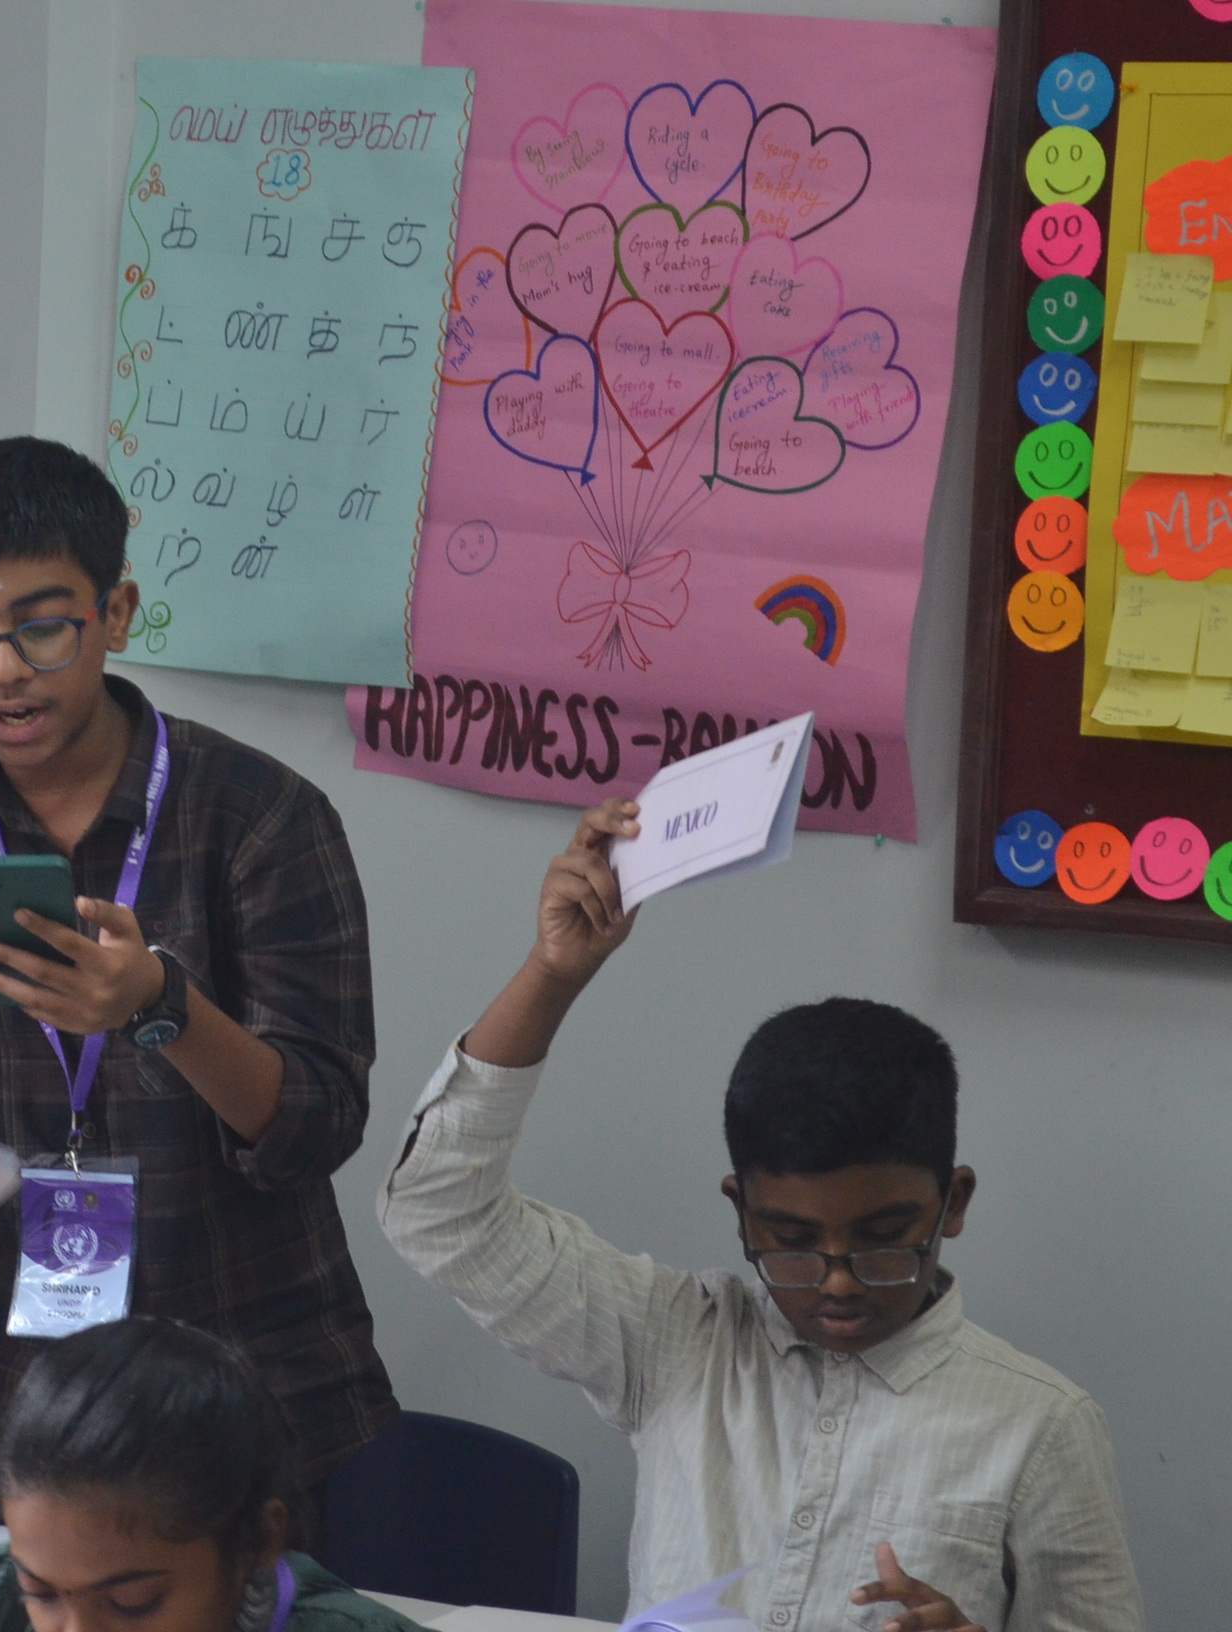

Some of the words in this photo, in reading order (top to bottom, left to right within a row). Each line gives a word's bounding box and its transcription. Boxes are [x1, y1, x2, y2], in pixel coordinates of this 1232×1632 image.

[648, 124, 690, 157] Riding
[700, 128, 709, 142] a
[265, 154, 302, 188] 18
[808, 150, 829, 170] to
[161, 203, 198, 249] க்
[245, 207, 293, 258] ங்
[322, 213, 365, 262] ச்
[629, 232, 670, 266] Going
[674, 231, 690, 248] to
[749, 268, 805, 302] Eating
[156, 305, 183, 343] ட்
[225, 301, 289, 351] ண்
[306, 310, 342, 360] த்
[614, 335, 651, 366] Going
[659, 339, 674, 357] to
[554, 371, 585, 395] with
[666, 372, 682, 391] to
[146, 380, 183, 427] ப்
[209, 387, 248, 432] ம்
[284, 392, 326, 441] ய்
[729, 430, 770, 466] Going
[780, 430, 803, 449] to
[130, 458, 176, 502] ல்
[193, 467, 236, 508] வ்
[266, 474, 299, 527] ழ்
[662, 800, 718, 844] MEXICO
